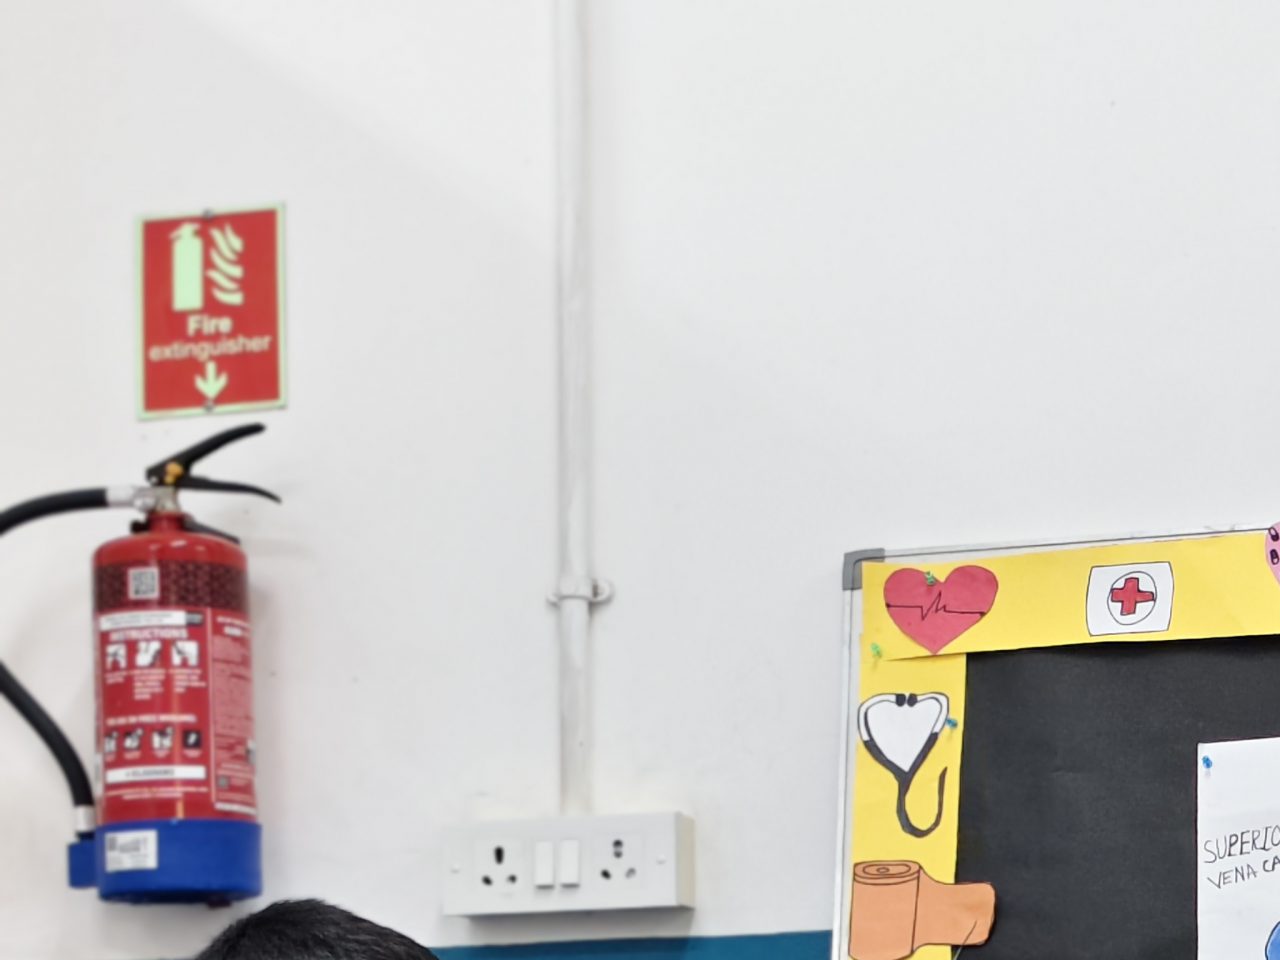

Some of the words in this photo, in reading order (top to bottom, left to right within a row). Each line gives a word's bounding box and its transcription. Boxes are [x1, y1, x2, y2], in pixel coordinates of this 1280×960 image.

[187, 314, 233, 337] Fire
[149, 334, 272, 362] extinguisher
[1207, 864, 1258, 889] VENA
